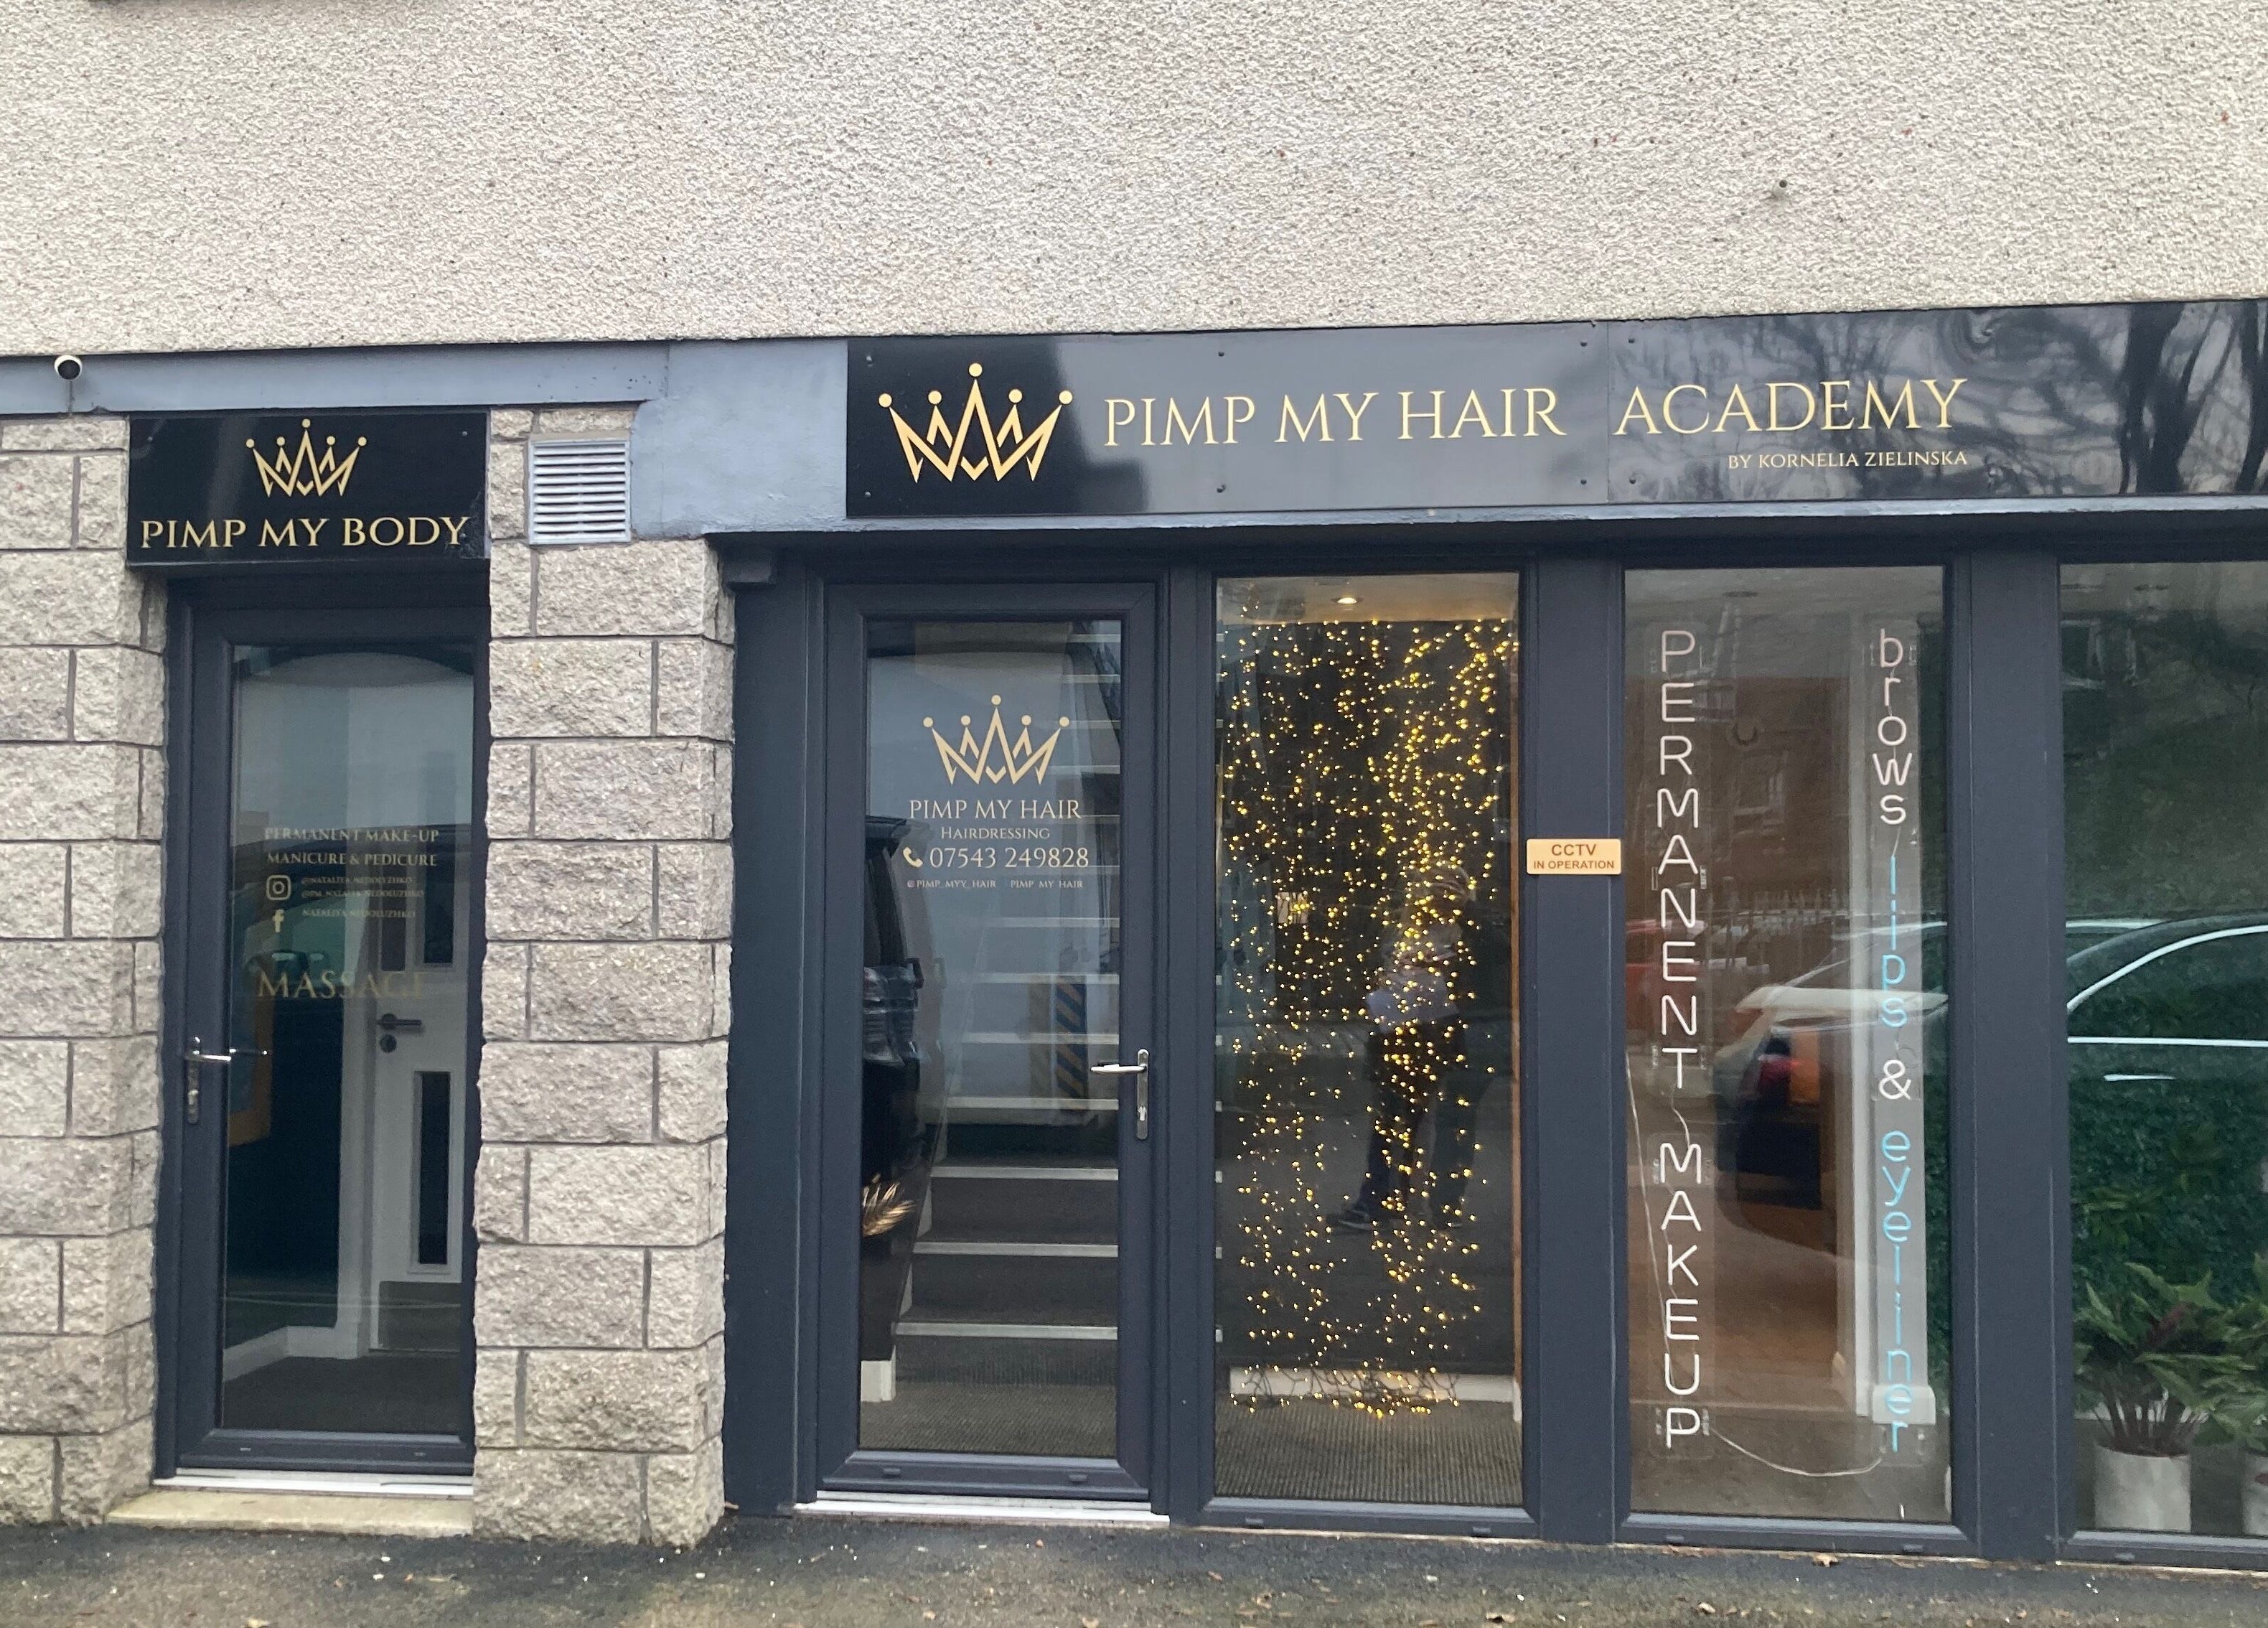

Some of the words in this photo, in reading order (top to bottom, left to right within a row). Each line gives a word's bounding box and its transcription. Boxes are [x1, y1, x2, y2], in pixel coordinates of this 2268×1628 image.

[1104, 396, 1255, 446] PIMP
[1274, 392, 1379, 444] MY
[1397, 388, 1568, 441] HAIR
[1613, 378, 1969, 436] ACADEMY
[1728, 454, 1752, 469] BY
[1759, 452, 1860, 468] KORNELIA
[1865, 450, 1968, 467] ZIELINSKA
[141, 519, 246, 549] PIMP
[258, 518, 330, 548] MY
[342, 515, 470, 547] BODY
[1872, 628, 1913, 826] brows
[909, 799, 967, 819] PIMP
[975, 799, 1013, 819] MY
[1020, 799, 1082, 820] HAIR
[265, 827, 360, 841] PERMANENT
[365, 829, 440, 843] MAKE-UP
[940, 826, 1051, 840] HAIRDRESSING
[267, 852, 347, 865] MANICURE
[365, 853, 438, 866] PEDICURE
[929, 847, 997, 869] 07543
[1004, 846, 1090, 869] 249828
[1551, 843, 1597, 856] CCTV
[1657, 629, 1700, 1090] PERMANENT
[1533, 860, 1545, 869] IN
[1547, 860, 1615, 869] OPERATION
[1059, 879, 1083, 889] HAIR
[1880, 855, 1907, 1029] lips
[1878, 1059, 1912, 1101] &
[1659, 1142, 1702, 1449] MAKEUP
[1881, 1130, 1913, 1454] eyeliner
